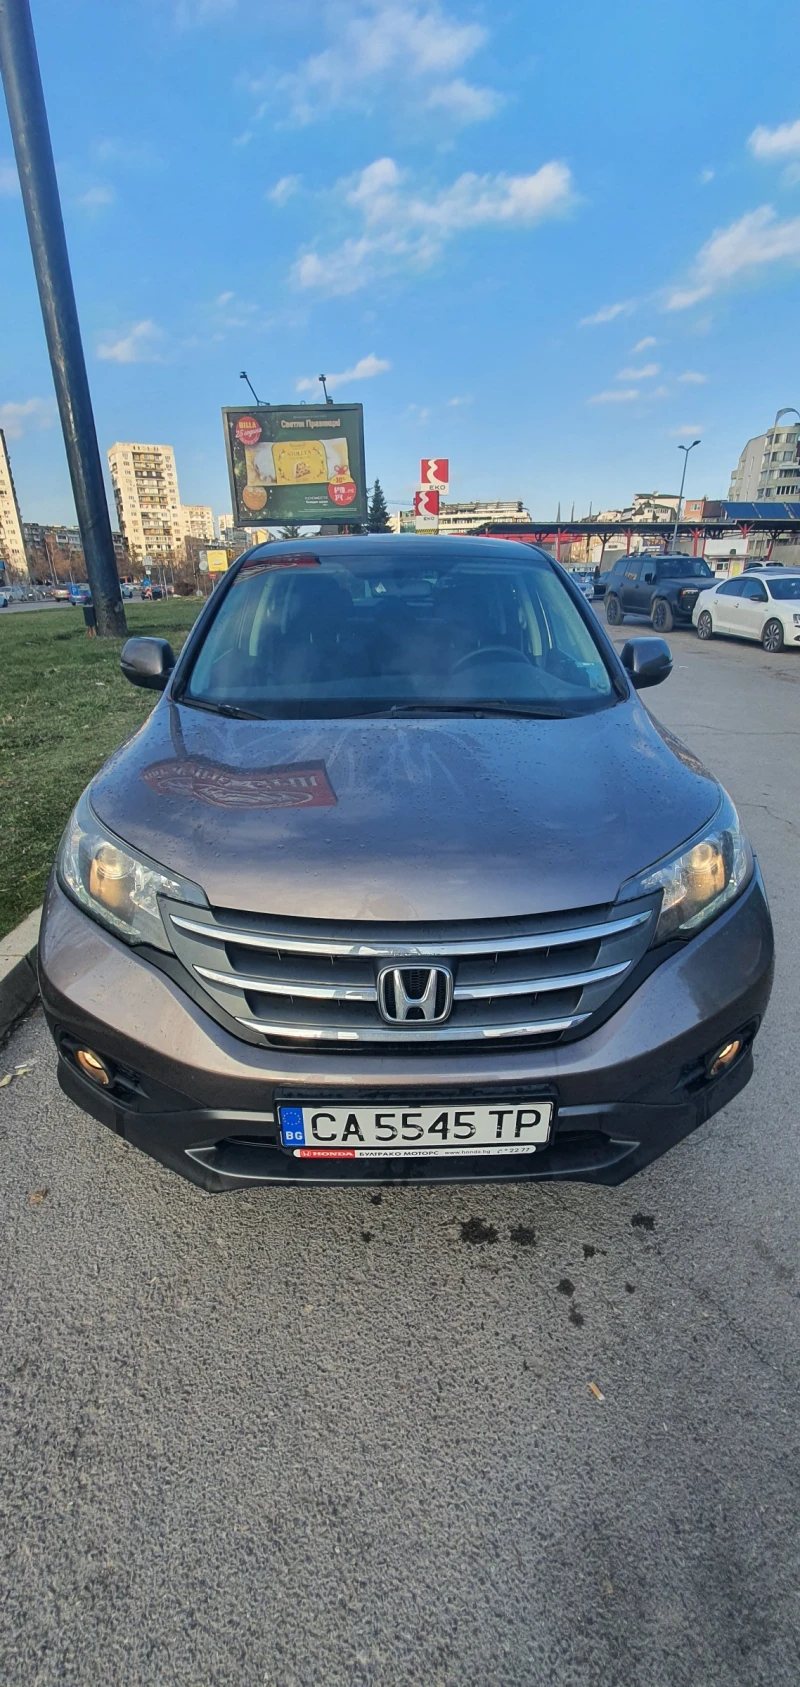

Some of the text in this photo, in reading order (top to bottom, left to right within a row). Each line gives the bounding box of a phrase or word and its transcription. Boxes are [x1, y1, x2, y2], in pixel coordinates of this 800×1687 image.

[238, 421, 257, 429] BILLA
[311, 1109, 542, 1143] CA 5545 TP
[285, 1130, 303, 1141] BG
